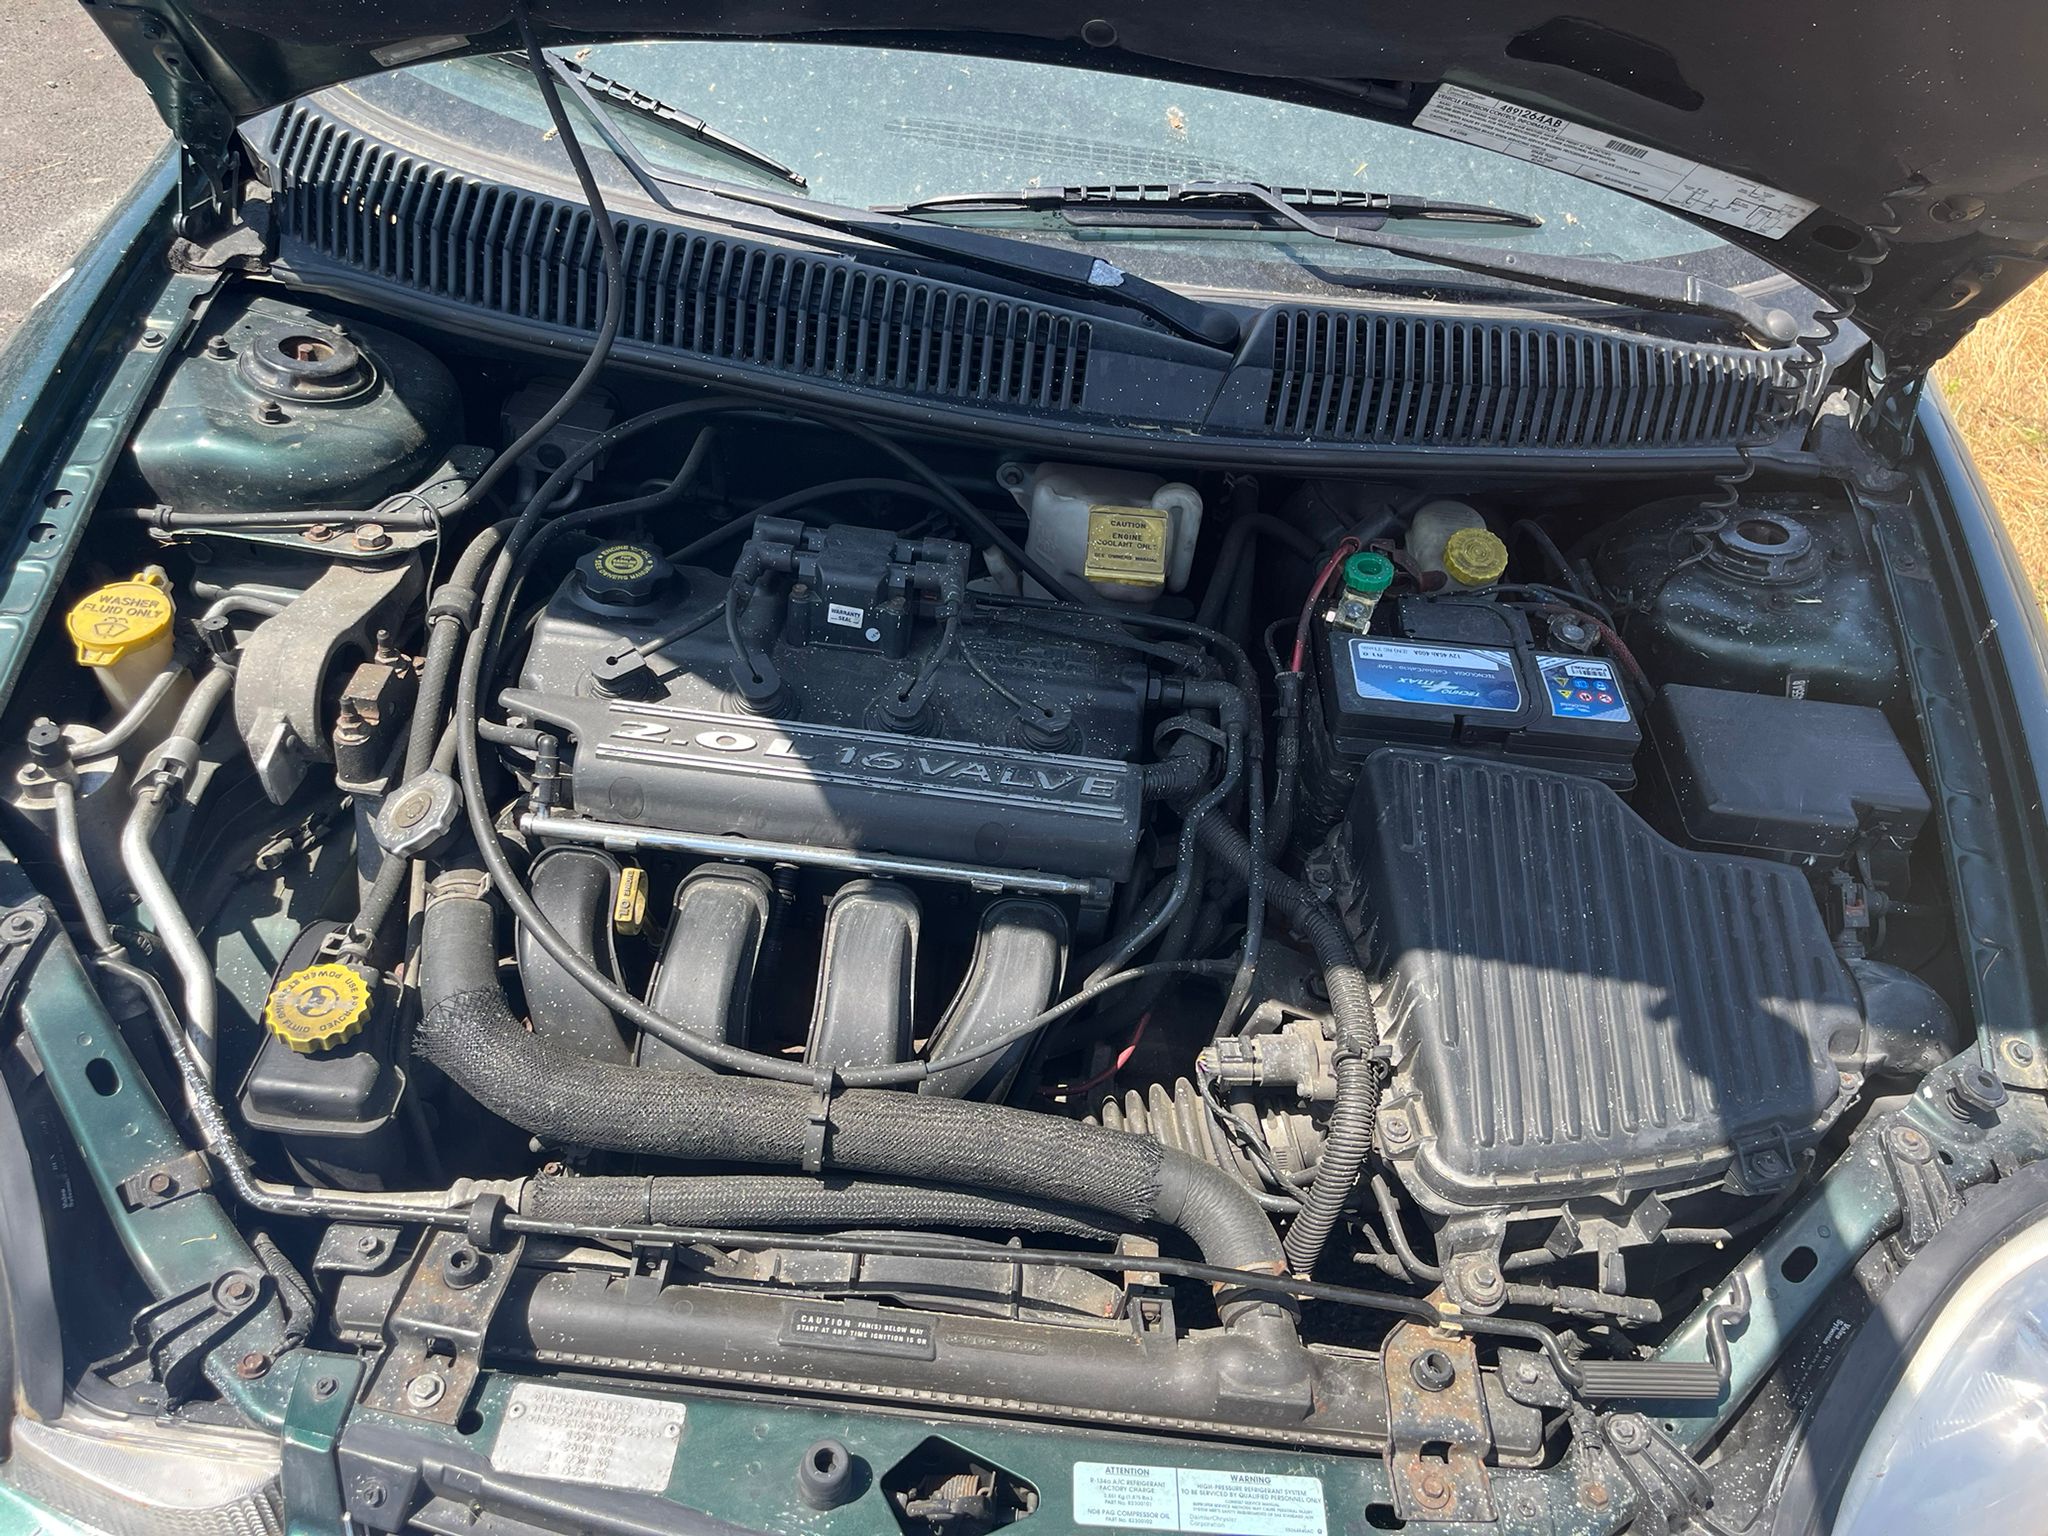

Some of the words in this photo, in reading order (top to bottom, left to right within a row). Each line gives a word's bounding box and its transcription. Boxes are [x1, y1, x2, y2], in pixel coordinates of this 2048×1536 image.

[1438, 93, 1460, 104] VEHICLE
[1462, 100, 1488, 112] EMISSION
[1489, 108, 1516, 120] CONTROL
[1517, 115, 1558, 133] INFORMATION
[1500, 104, 1562, 128] 4891264AB
[1110, 520, 1146, 528] CAUTION
[1096, 539, 1132, 548] COOLANT
[1112, 532, 1142, 542] ENGINE
[100, 594, 160, 608] WASHER
[81, 602, 122, 614] FLUID
[126, 608, 164, 618] ONLY
[831, 608, 861, 618] WARRANTY
[837, 746, 904, 772] 16
[918, 756, 1121, 798] VALVE
[619, 900, 630, 918] OIL
[303, 970, 344, 980] POWER
[344, 978, 358, 993] USE
[282, 1020, 311, 1033] FLUID
[801, 1314, 851, 1328] CAUTION
[858, 1322, 882, 1331] FAN(S)
[884, 1324, 908, 1334] BELOW
[796, 1324, 819, 1332] START
[832, 1328, 848, 1336] ANY
[850, 1330, 868, 1338] TIME
[870, 1332, 904, 1342] IGNITION
[1105, 1466, 1149, 1475] ATTENTION
[1230, 1474, 1271, 1483] WARNING
[1116, 1510, 1158, 1518] COMPRESSOR
